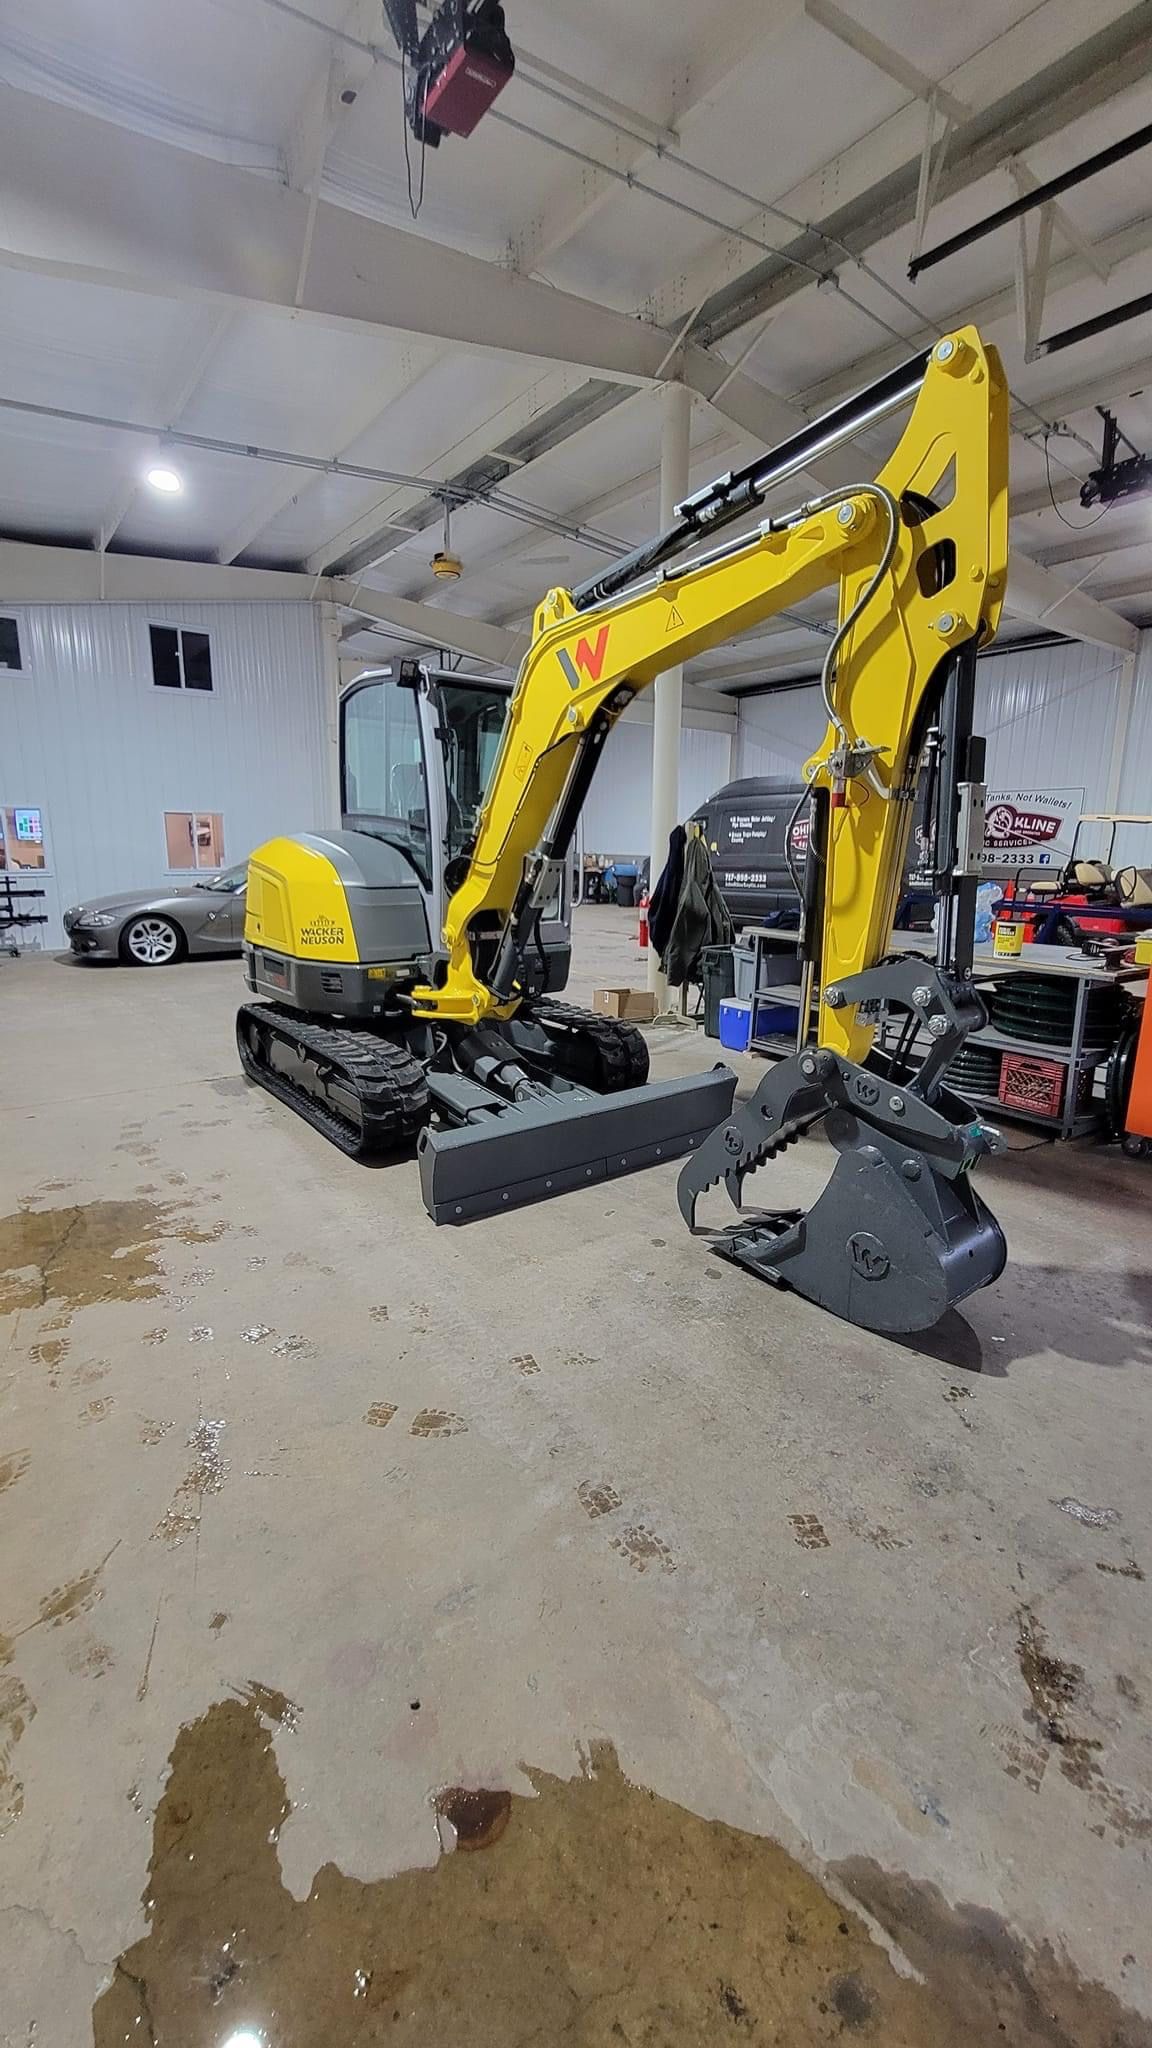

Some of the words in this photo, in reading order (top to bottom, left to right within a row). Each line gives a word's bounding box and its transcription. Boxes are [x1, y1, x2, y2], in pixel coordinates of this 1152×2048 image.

[1016, 793, 1032, 802] Not
[1035, 794, 1072, 810] Wallets!
[1014, 816, 1057, 834] KLINE
[301, 928, 344, 936] WACKER
[301, 936, 344, 944] NEUSON
